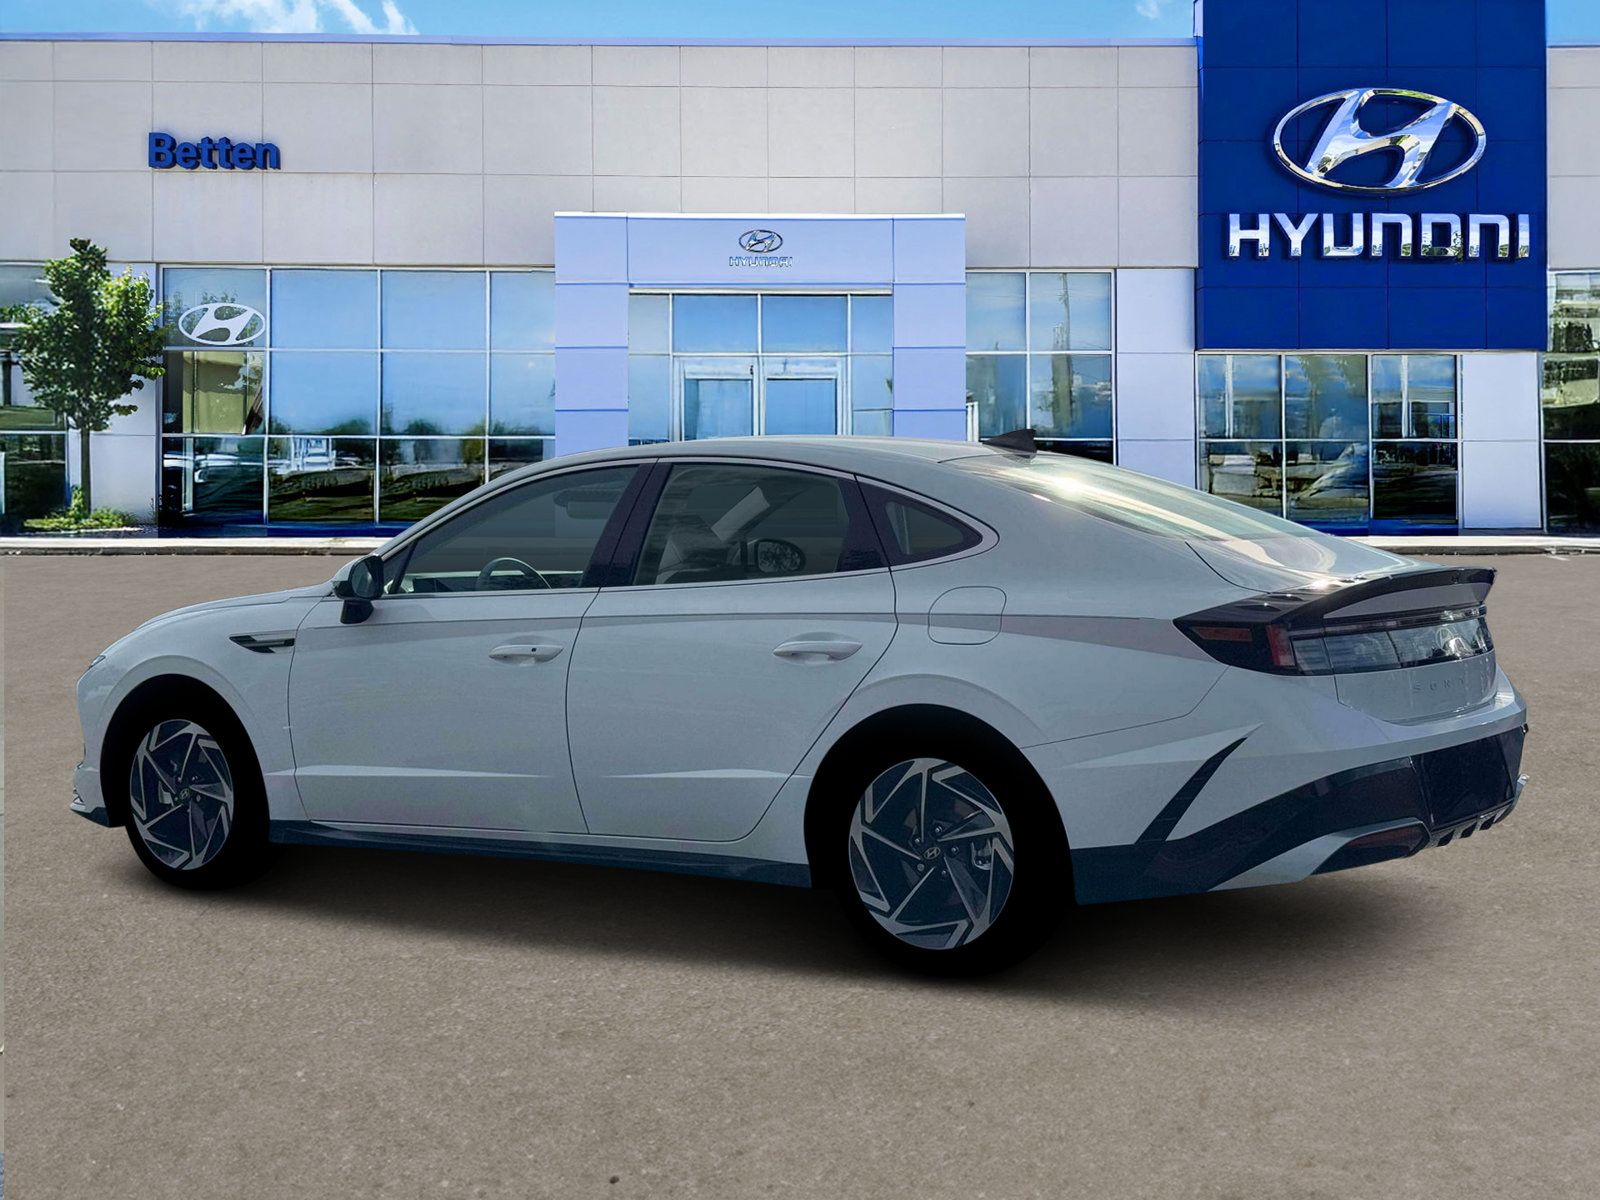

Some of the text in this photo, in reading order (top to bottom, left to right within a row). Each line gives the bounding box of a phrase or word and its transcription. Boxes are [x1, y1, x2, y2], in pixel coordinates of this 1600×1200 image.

[148, 132, 281, 170] Betten
[1229, 213, 1530, 258] HYUNDAI
[728, 256, 793, 267] HYUNDAI
